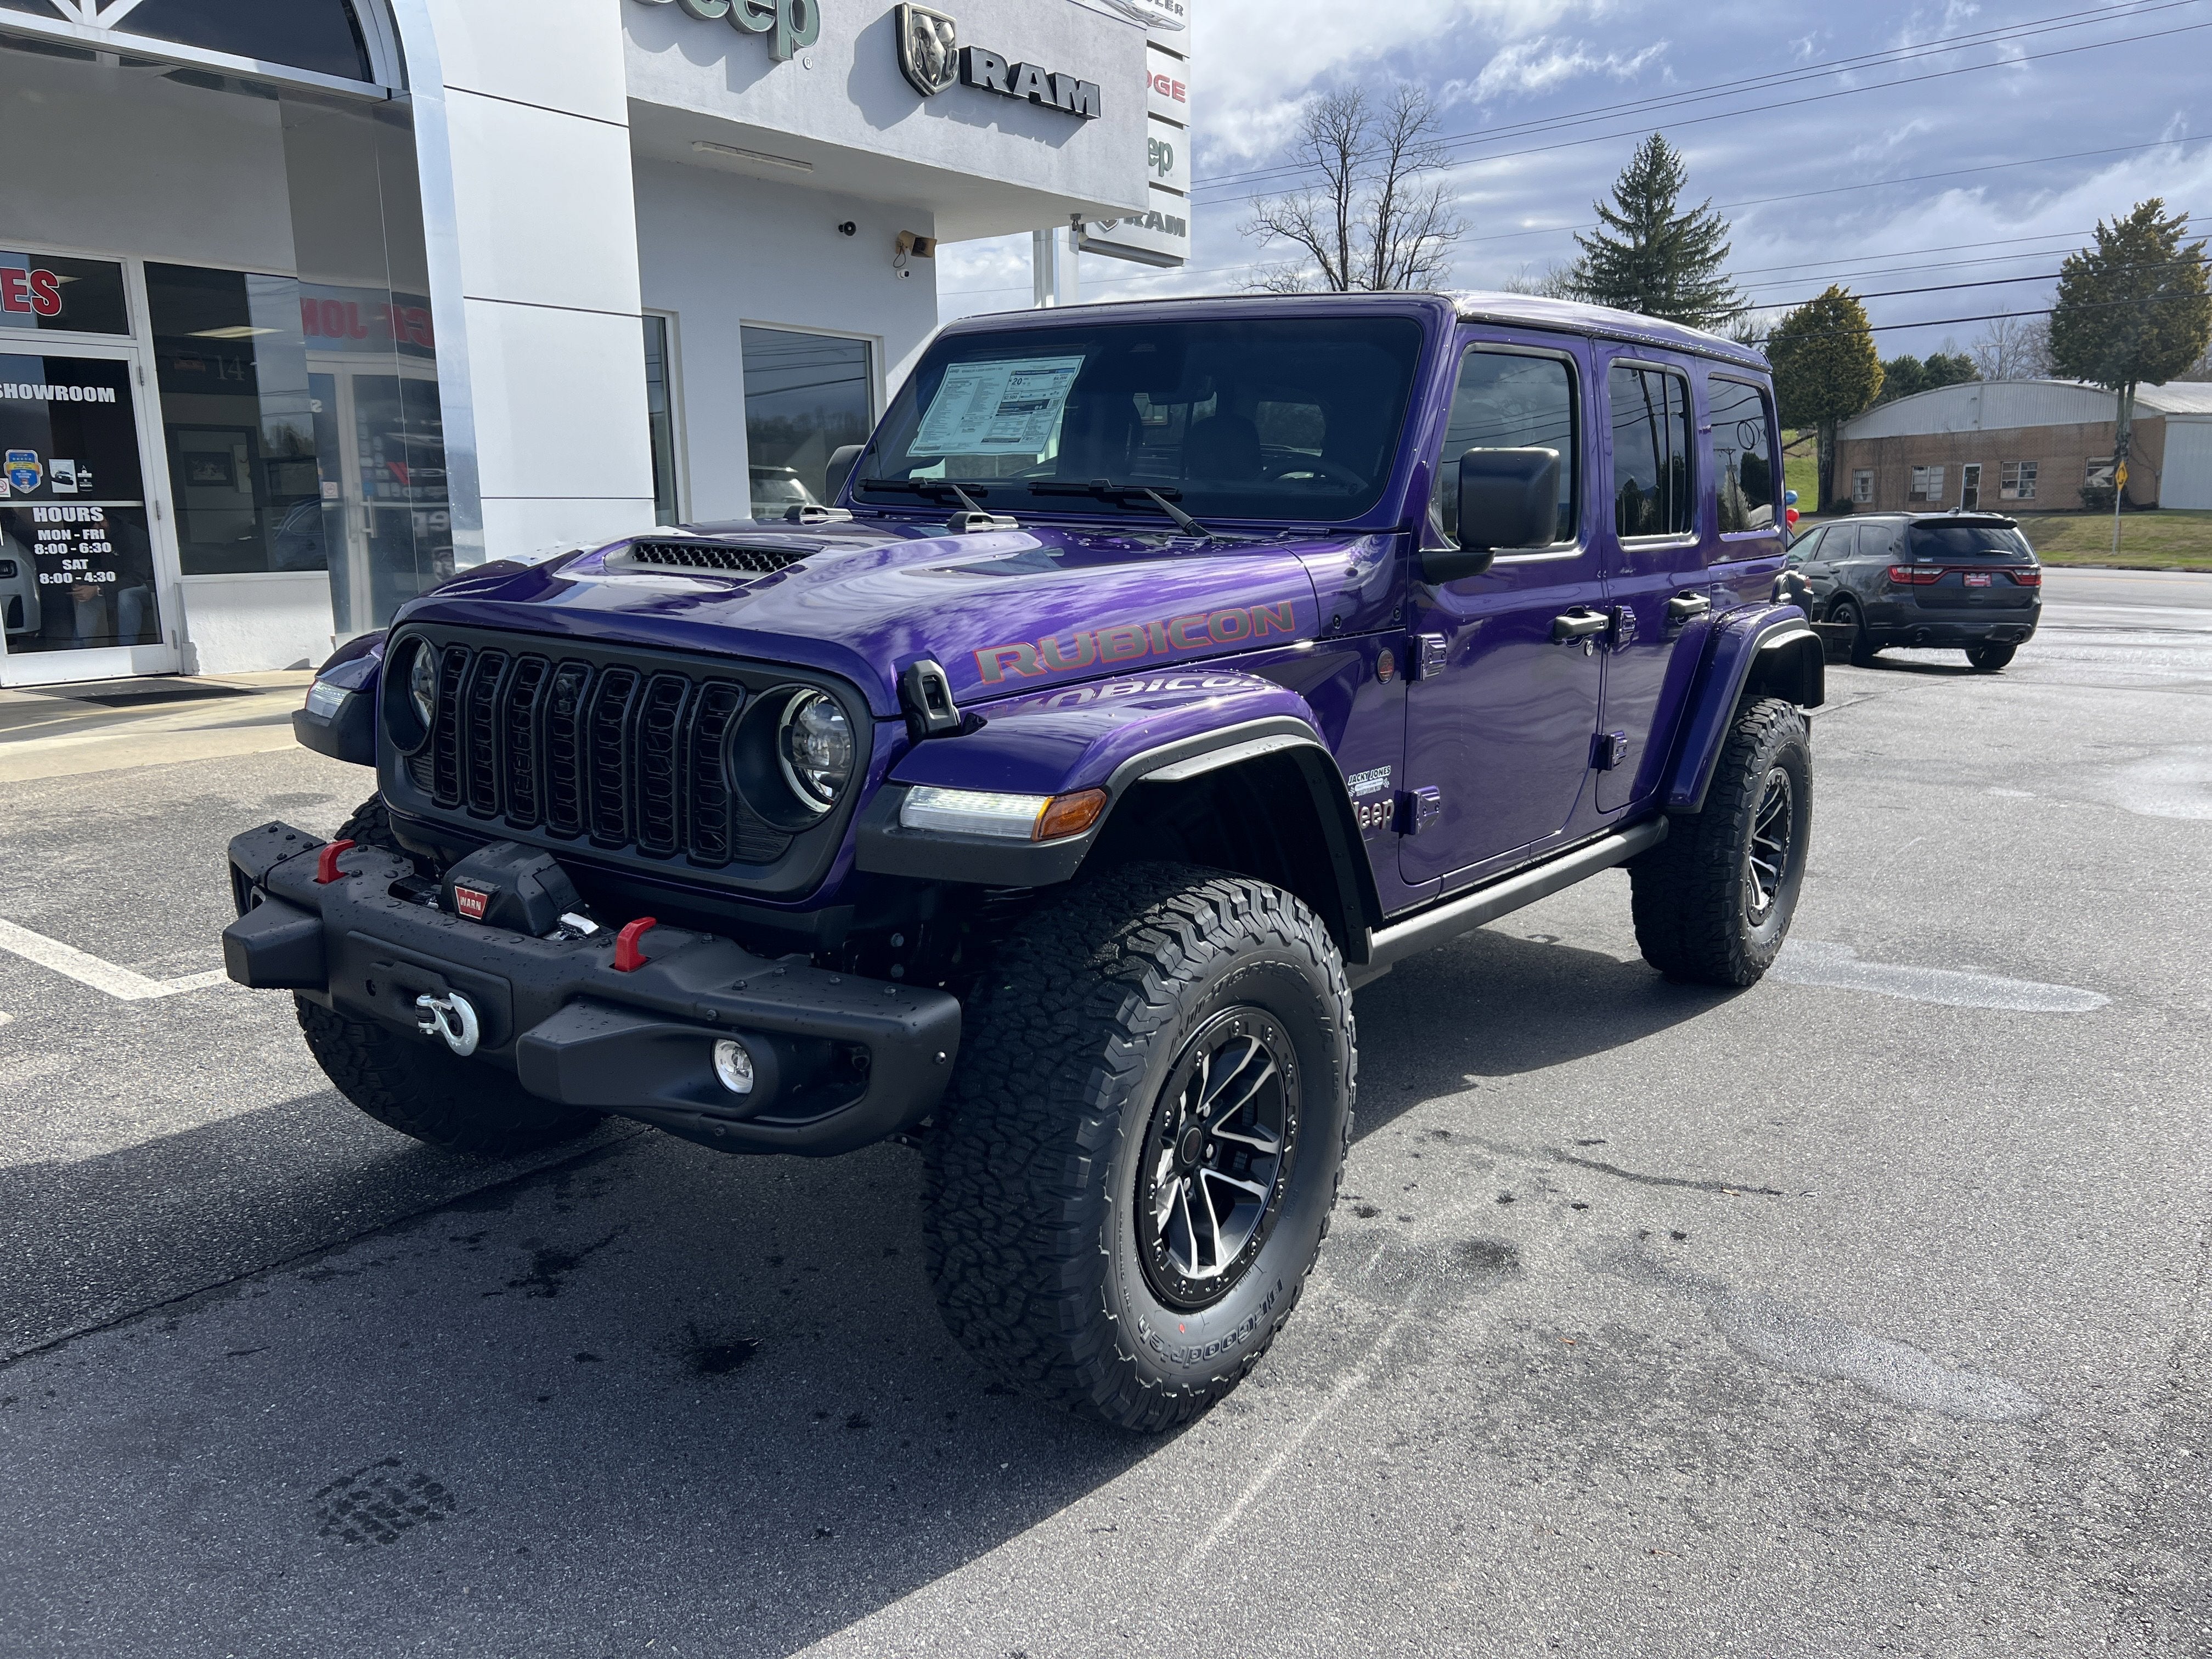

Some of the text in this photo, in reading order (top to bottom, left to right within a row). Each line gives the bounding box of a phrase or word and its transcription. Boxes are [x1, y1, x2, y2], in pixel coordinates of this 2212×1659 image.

[960, 46, 1101, 119] RAM
[0, 383, 116, 403] HOWROOM
[32, 507, 104, 522] HOURS
[37, 529, 72, 540] MON
[82, 529, 105, 540] FRI
[34, 543, 68, 555] 8:00
[79, 542, 111, 554] 6:30
[62, 559, 88, 570] SAT
[39, 573, 73, 584] 8:00
[84, 571, 116, 583] 4:30
[973, 601, 1295, 685] RUBICON
[1348, 771, 1370, 786] JACKY
[1369, 765, 1391, 780] JONES
[460, 896, 481, 911] WARN
